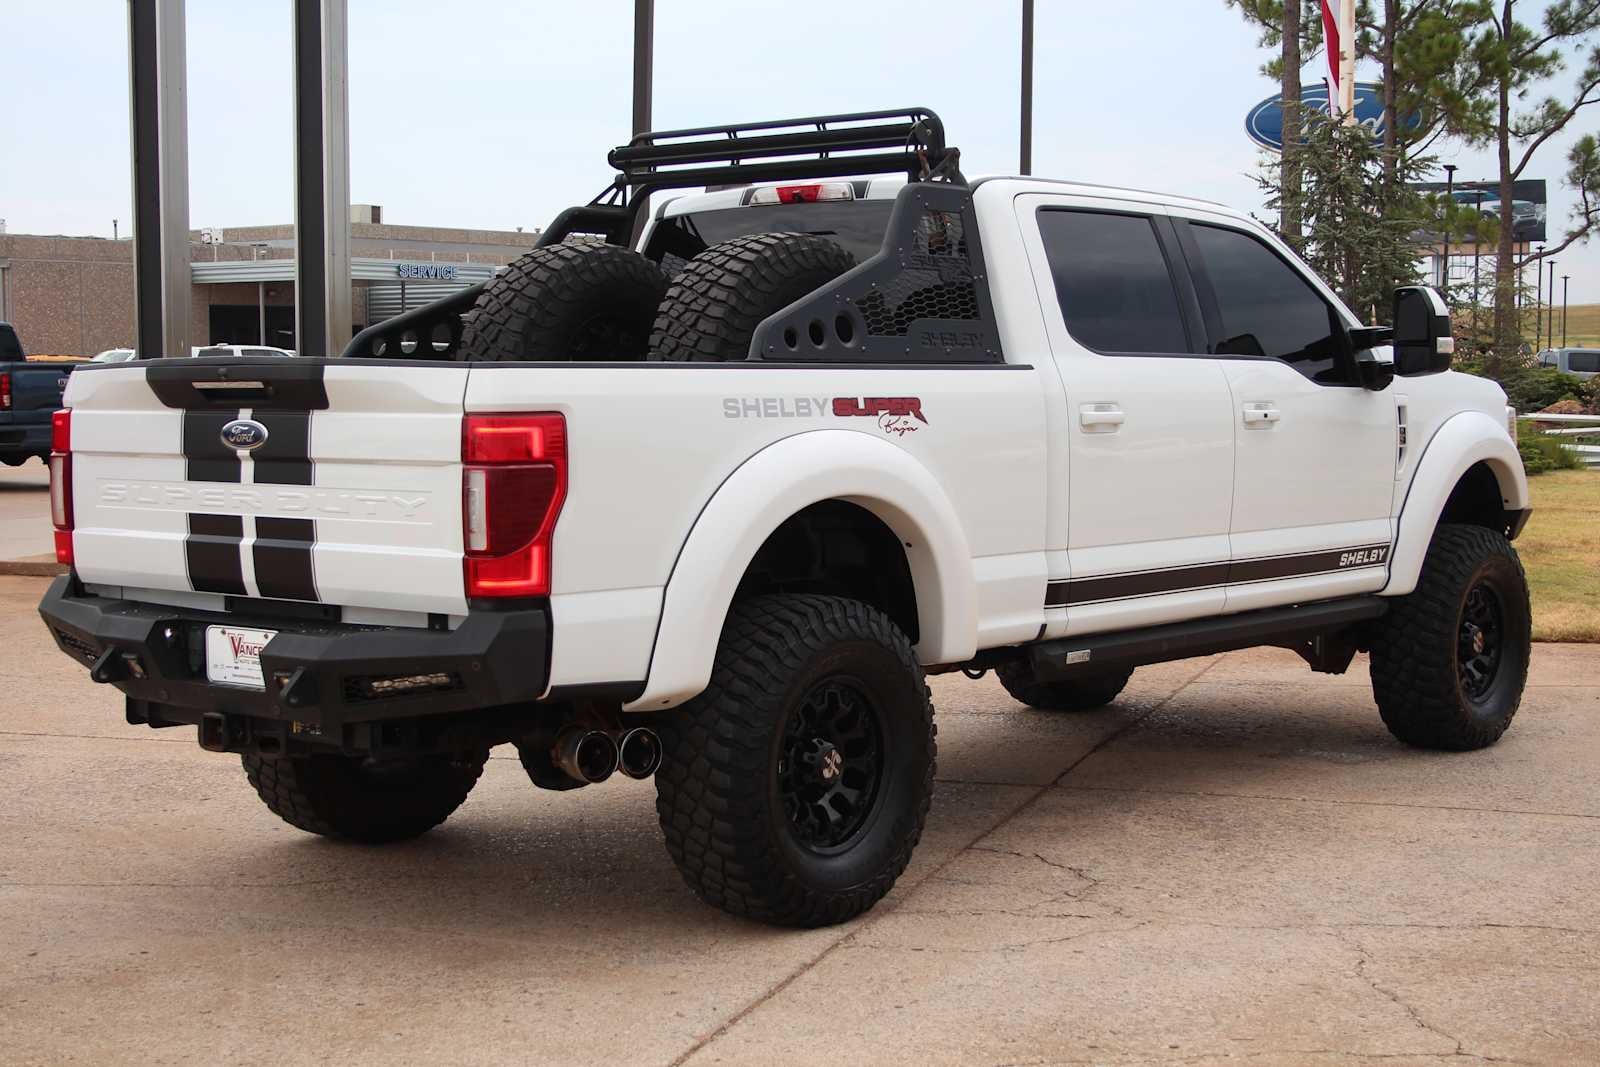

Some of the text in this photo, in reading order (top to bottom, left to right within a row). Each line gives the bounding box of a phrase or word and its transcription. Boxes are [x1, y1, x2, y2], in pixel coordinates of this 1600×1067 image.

[398, 264, 459, 279] SERVICE
[722, 397, 929, 425] SHELBY SUPER
[228, 425, 256, 442] Ford
[101, 483, 427, 517] SUPER DUTY
[1339, 548, 1387, 567] SHELBY
